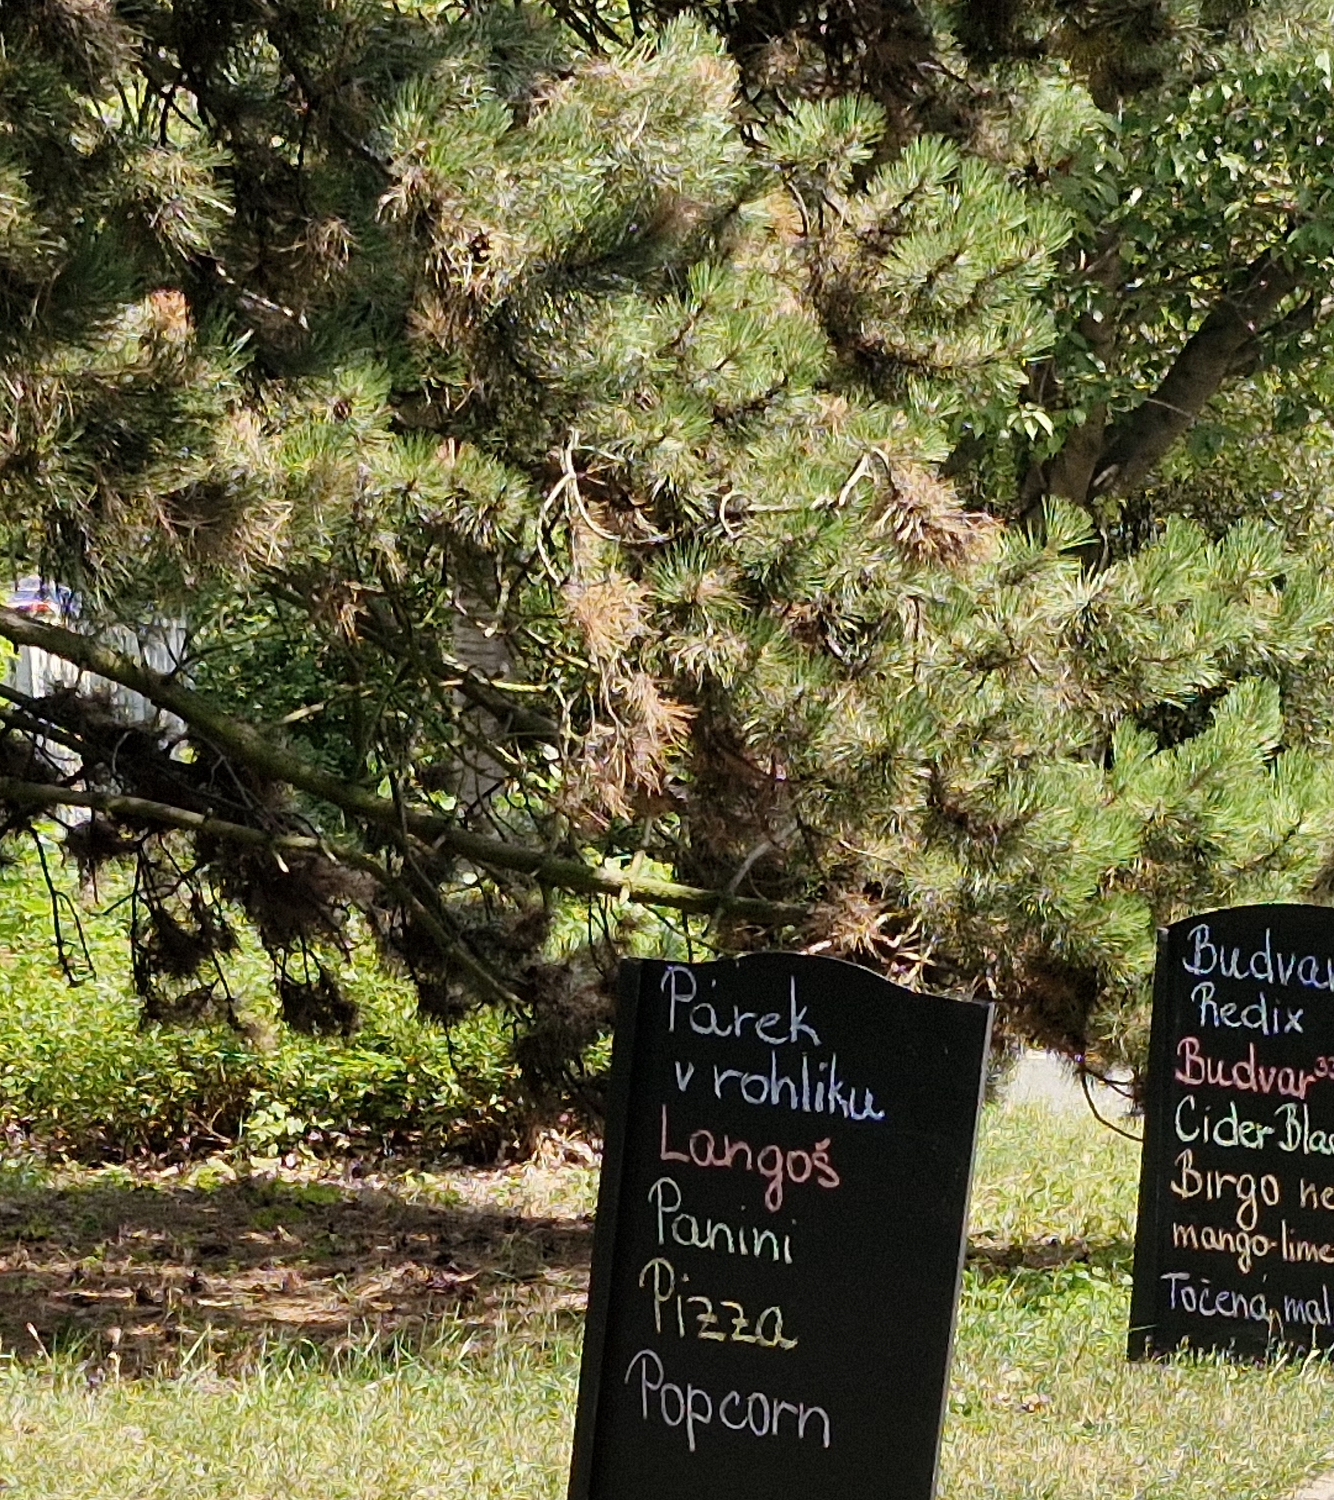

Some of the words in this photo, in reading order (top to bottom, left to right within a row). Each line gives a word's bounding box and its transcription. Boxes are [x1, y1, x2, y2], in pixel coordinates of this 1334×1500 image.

[660, 964, 823, 1046] Párek
[1191, 981, 1304, 1036] Redix
[675, 1060, 695, 1092] v
[660, 1103, 840, 1213] Langoš
[1174, 1094, 1276, 1150] Cider
[648, 1176, 797, 1265] Panini
[639, 1256, 798, 1350] Pizza
[1161, 1272, 1270, 1323] Točená
[624, 1348, 831, 1452] Popcorn
